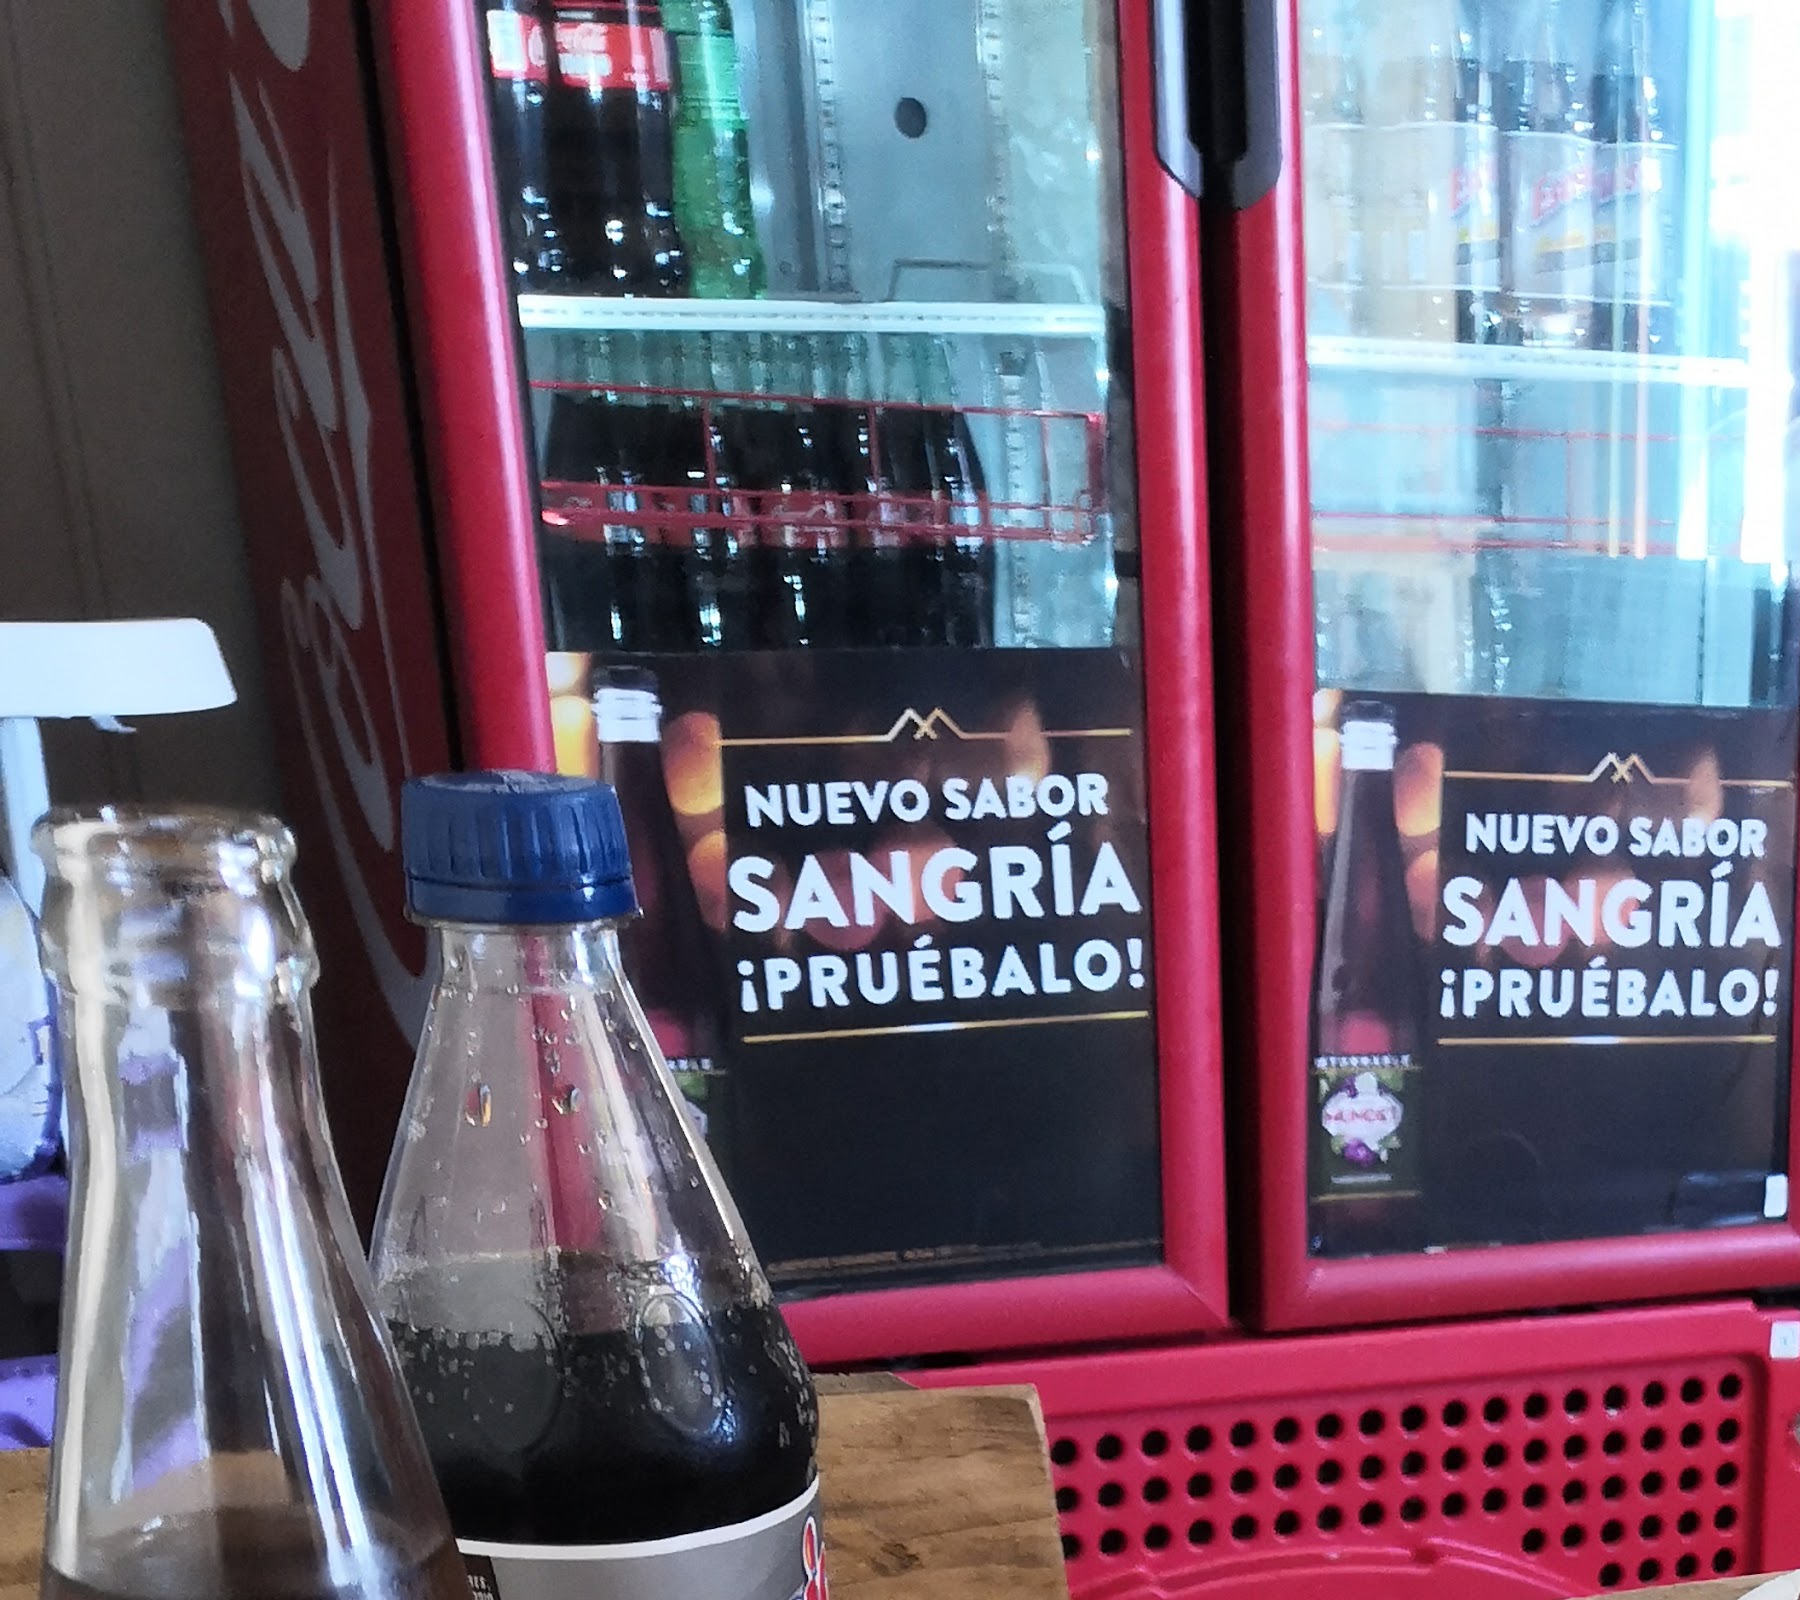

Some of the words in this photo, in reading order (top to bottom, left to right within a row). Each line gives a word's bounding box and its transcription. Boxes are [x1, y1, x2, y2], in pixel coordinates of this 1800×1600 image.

[744, 779, 930, 828] NUEVO
[942, 773, 1110, 820] SABOR
[1465, 813, 1619, 856] NUEVO
[1630, 818, 1769, 858] SABOR
[727, 822, 1142, 934] SANGRÍA
[1441, 862, 1782, 948] SANGRÍA
[739, 934, 1146, 1013] ¡PRUÉBALO!
[1439, 956, 1780, 1019] ¡PRUÉBALO!
